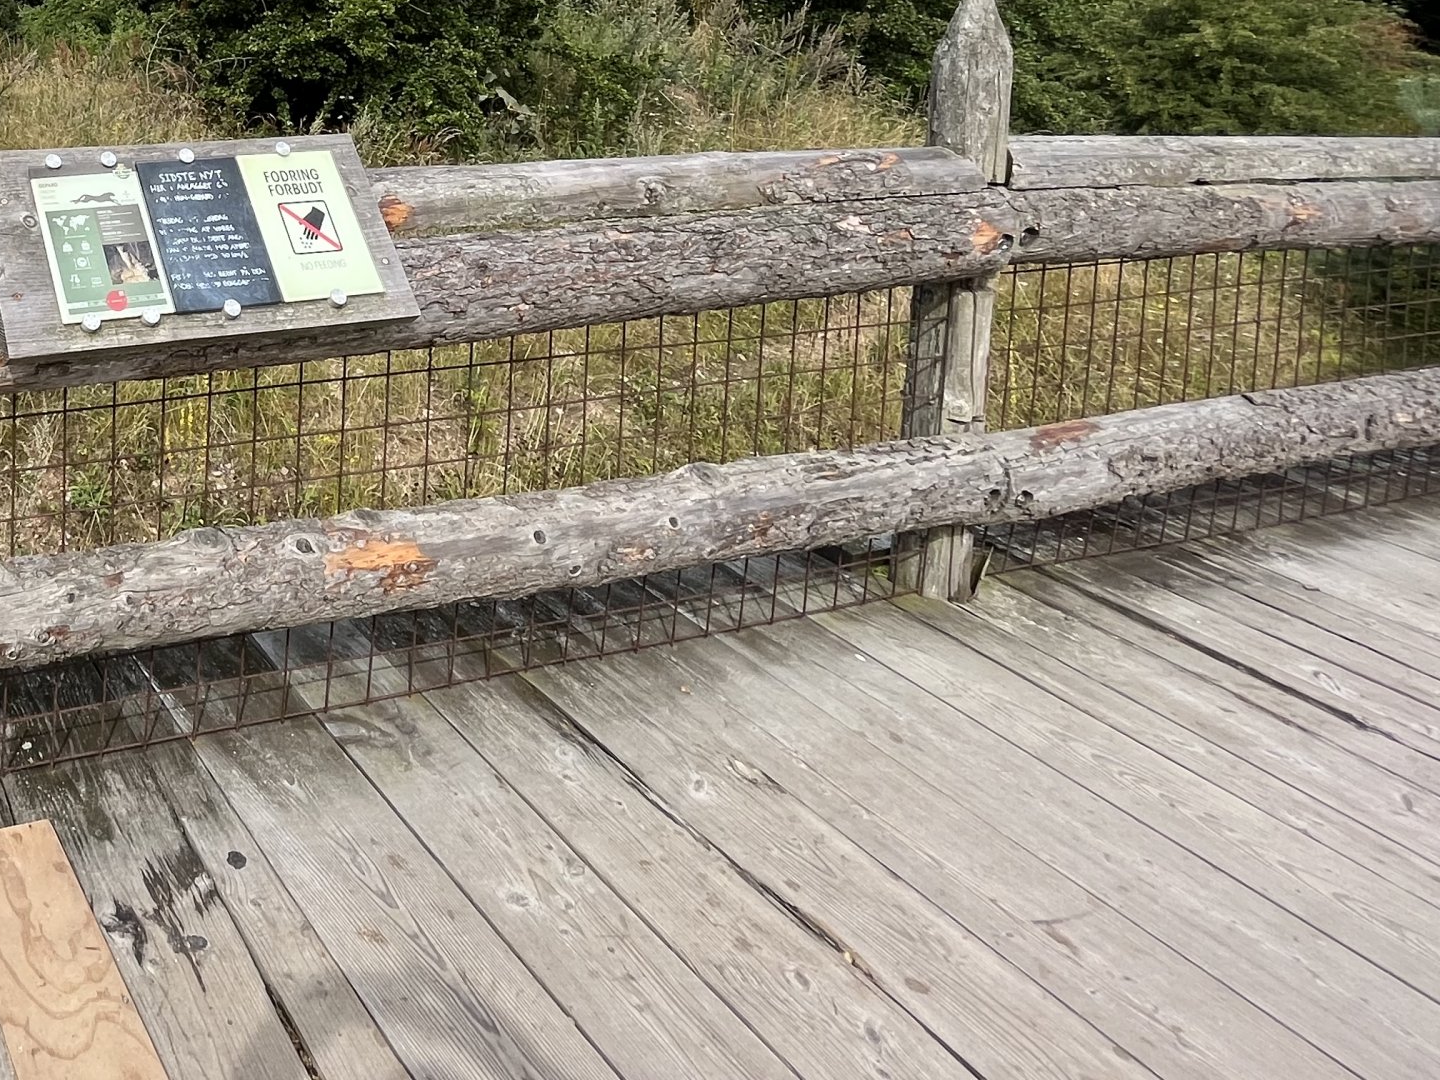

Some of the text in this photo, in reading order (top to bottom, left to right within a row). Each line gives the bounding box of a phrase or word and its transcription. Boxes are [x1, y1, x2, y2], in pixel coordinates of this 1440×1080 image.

[158, 169, 222, 183] SIDSTE NYT
[263, 168, 319, 183] FODRING
[268, 181, 324, 197] FORBUDT
